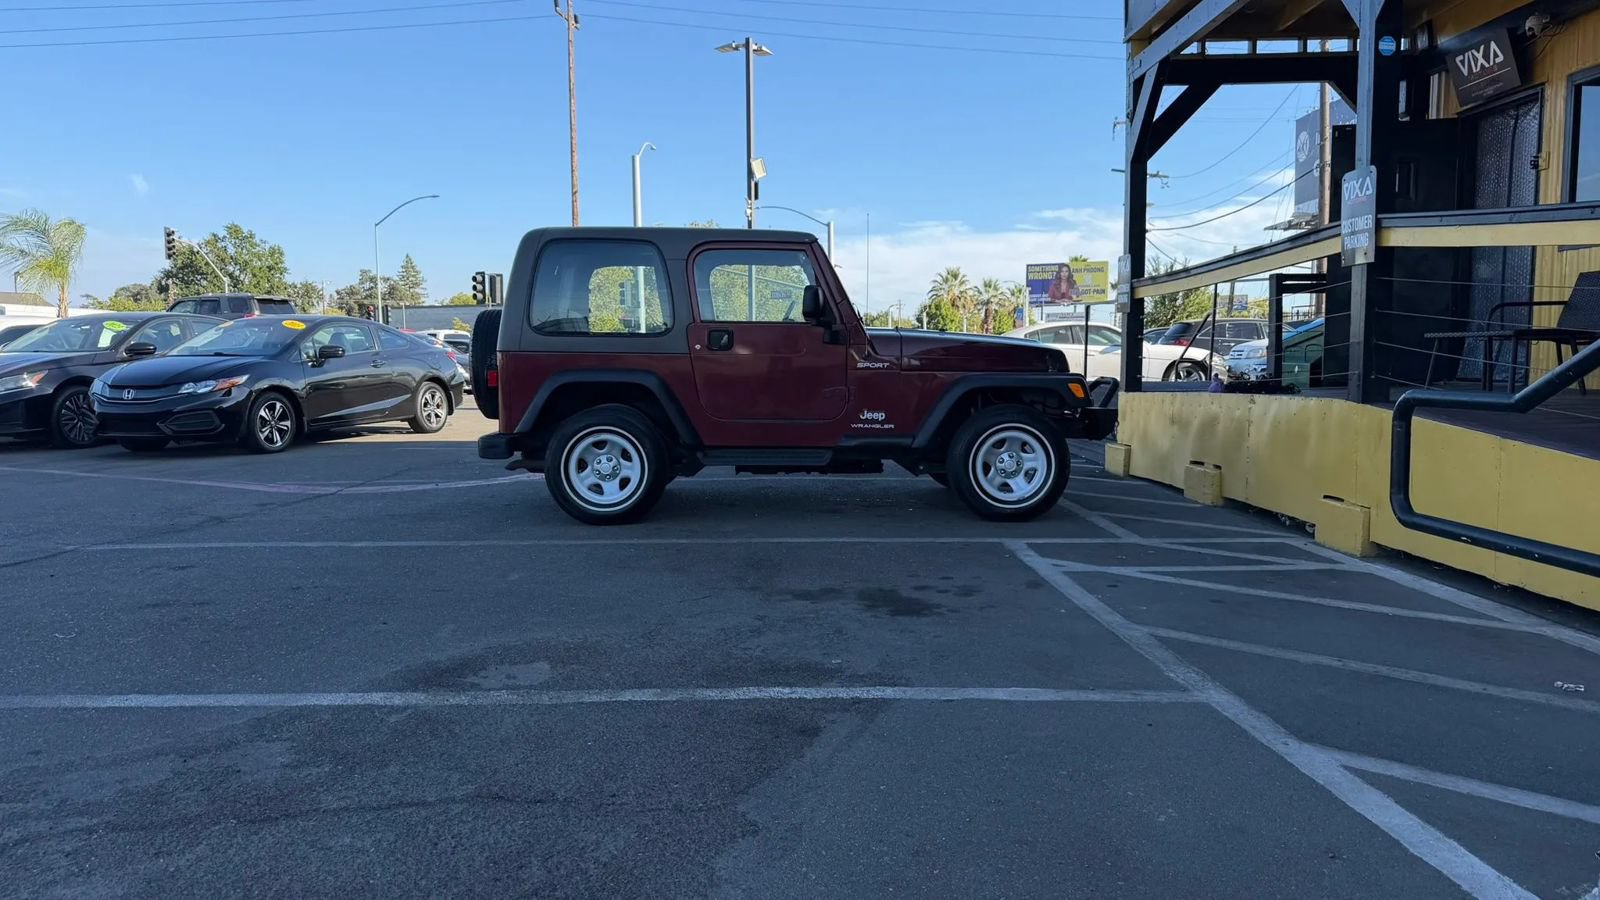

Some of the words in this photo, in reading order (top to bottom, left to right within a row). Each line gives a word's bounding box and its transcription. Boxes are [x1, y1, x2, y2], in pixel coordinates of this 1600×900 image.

[1455, 40, 1504, 76] VIXA
[1343, 176, 1373, 201] VIXA
[1342, 215, 1373, 234] CUSTOMER
[1344, 232, 1369, 250] PARKING
[1028, 271, 1057, 280] WRONG?
[860, 410, 886, 421] Jeep
